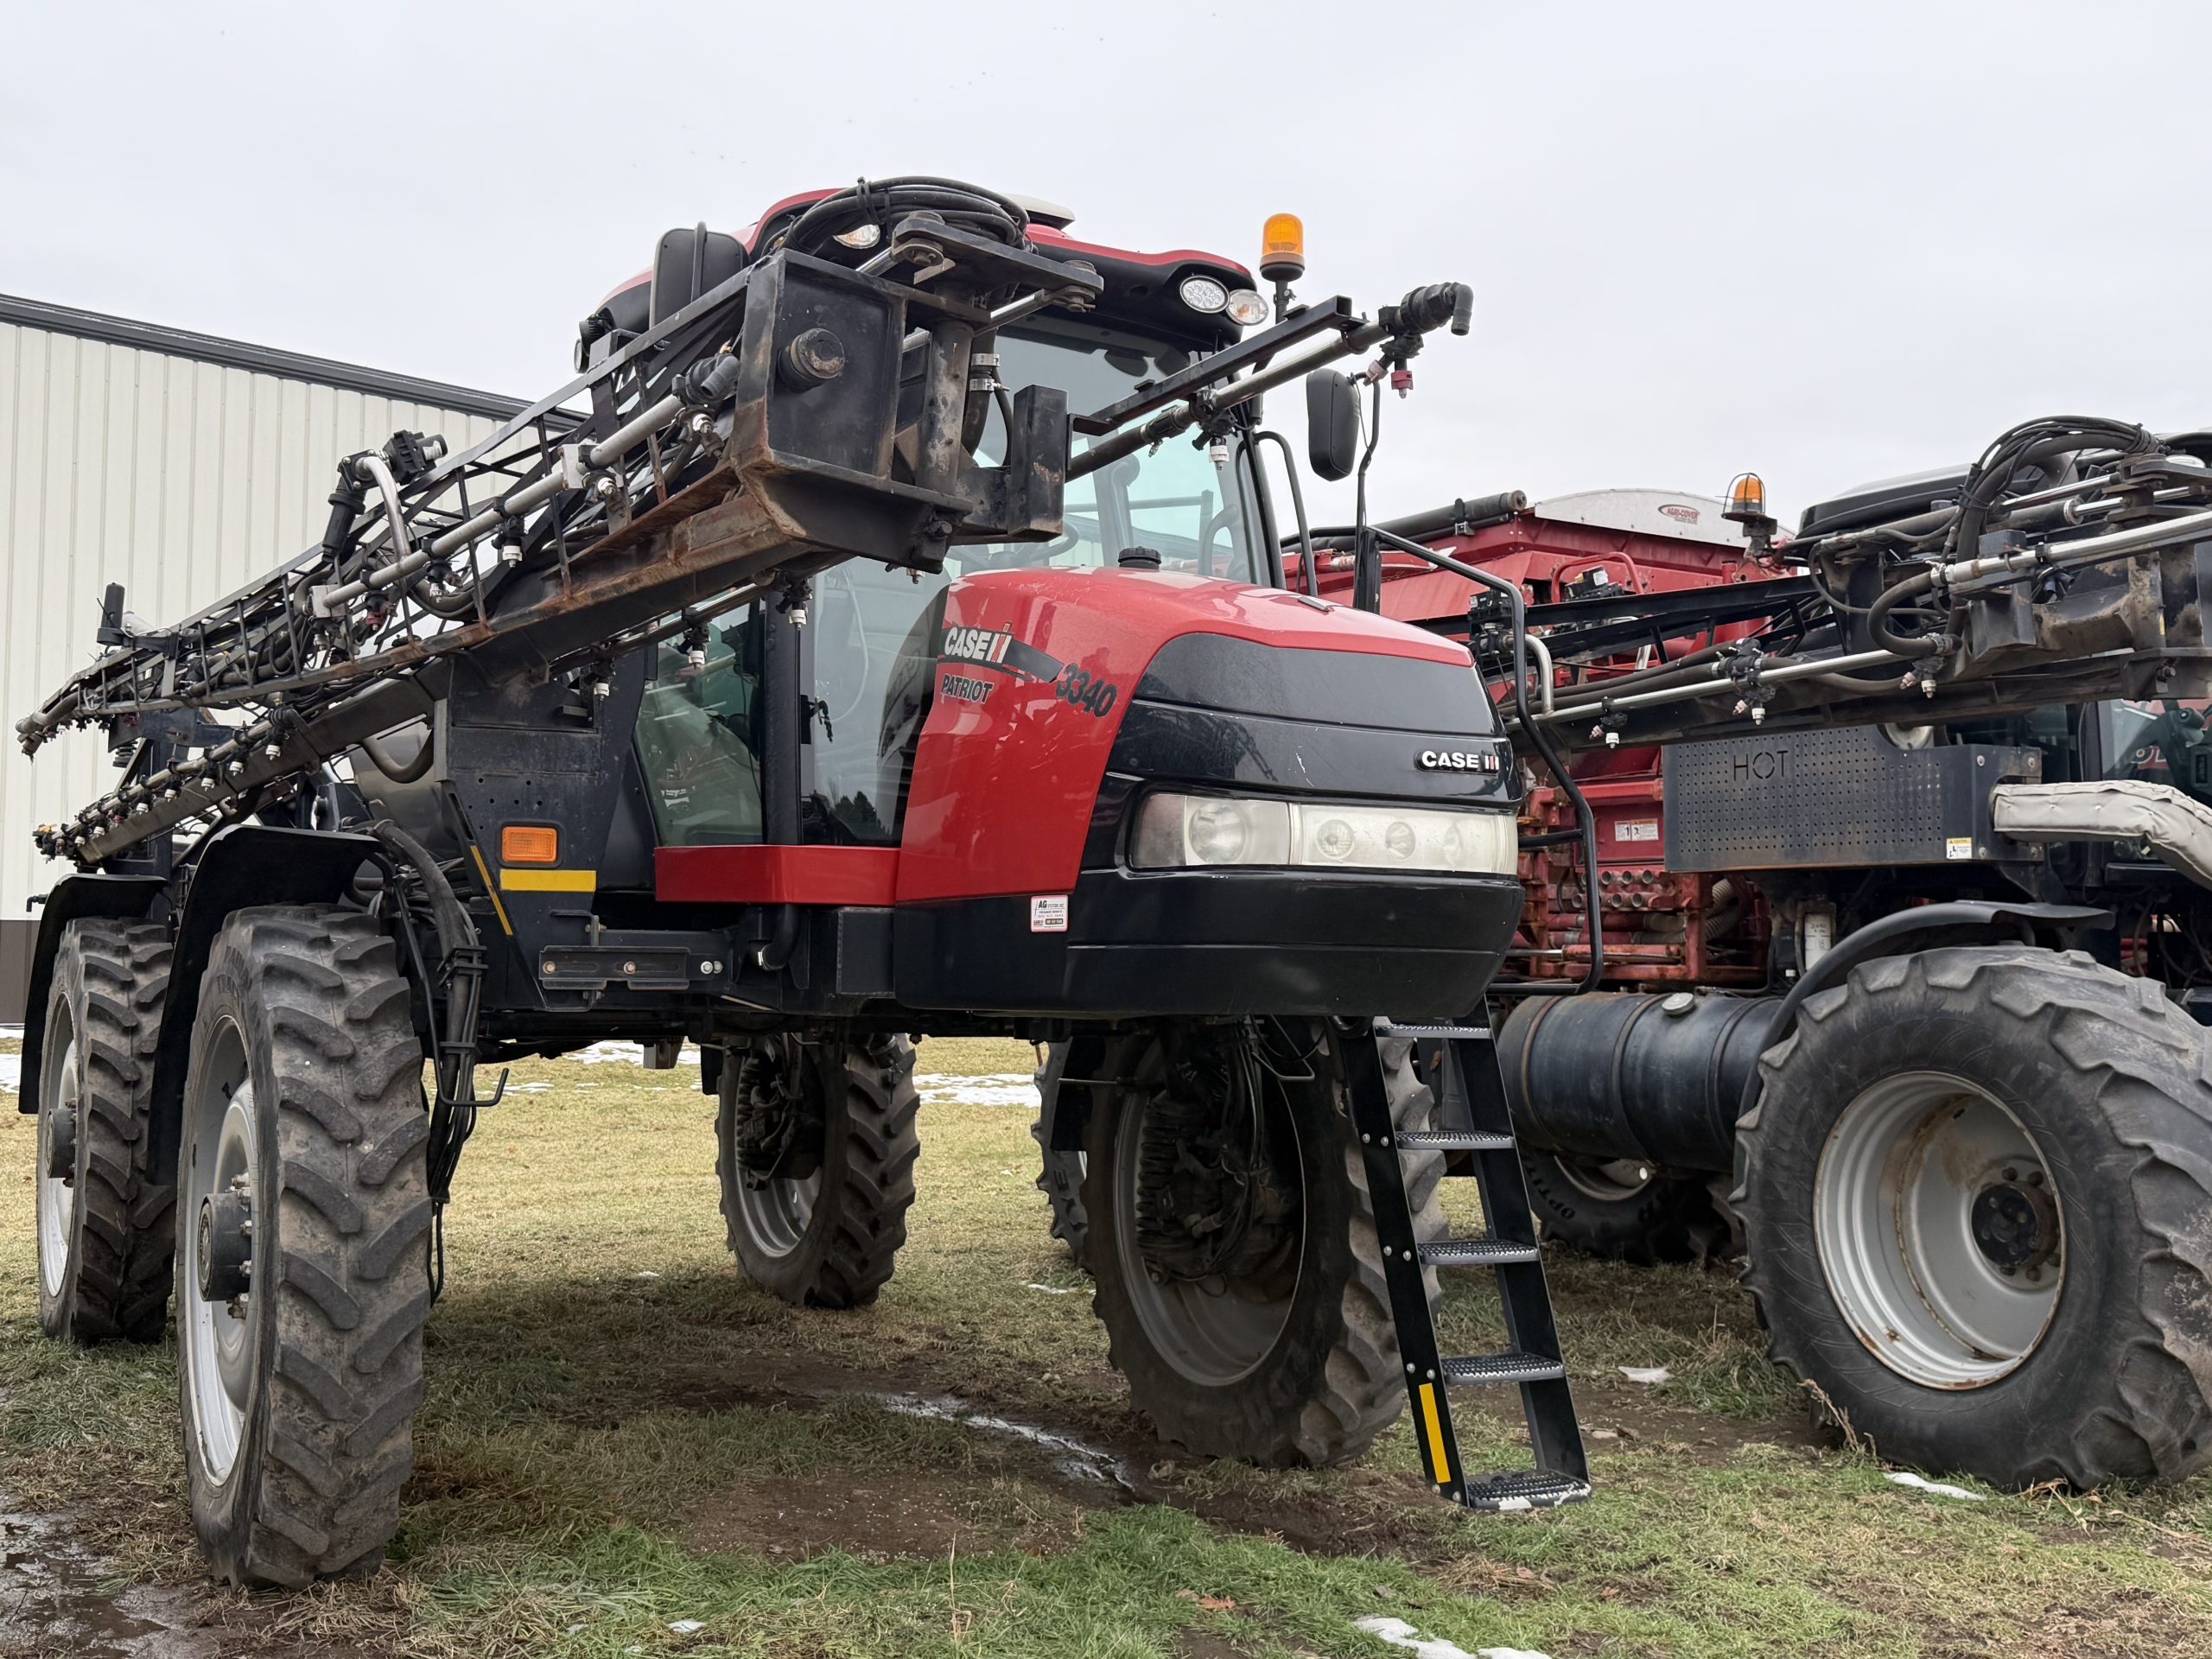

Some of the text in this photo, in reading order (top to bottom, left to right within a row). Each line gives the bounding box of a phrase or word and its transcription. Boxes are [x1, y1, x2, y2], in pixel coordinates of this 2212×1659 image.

[944, 626, 988, 661] CASE
[940, 673, 994, 704] PATRIOT
[1056, 663, 1117, 717] 3340
[1421, 750, 1479, 769] CASE
[1733, 749, 1789, 781] HOT
[1038, 899, 1048, 909] AG
